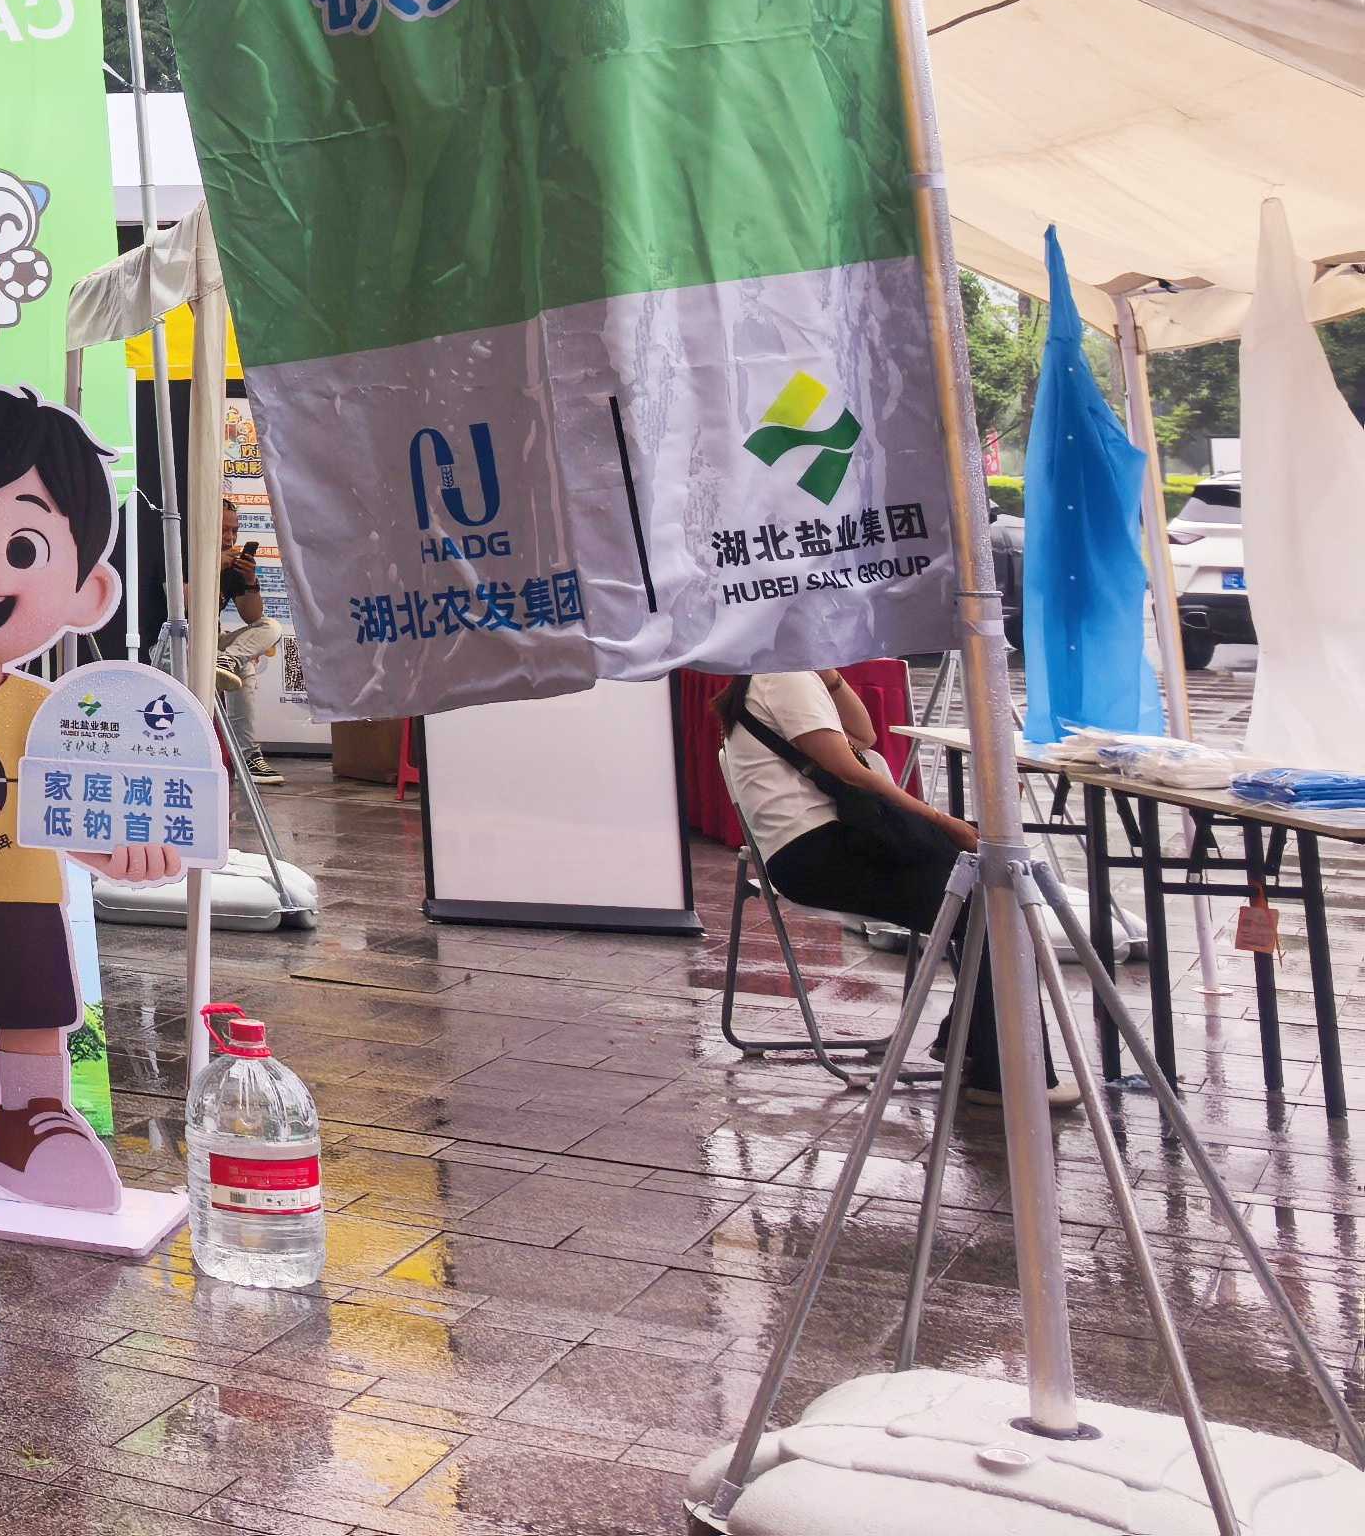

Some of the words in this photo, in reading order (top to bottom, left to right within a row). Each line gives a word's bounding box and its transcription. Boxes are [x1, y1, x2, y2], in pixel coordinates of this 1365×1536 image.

[420, 531, 512, 564] HADG
[711, 503, 928, 570] 湖北盐业集团
[723, 576, 800, 606] HUBEI
[805, 562, 854, 593] SALT
[857, 555, 932, 587] GROUP
[350, 569, 586, 646] 湖北农发集团
[44, 770, 194, 810] 家庭减盐
[43, 805, 195, 846] 低钠首选
